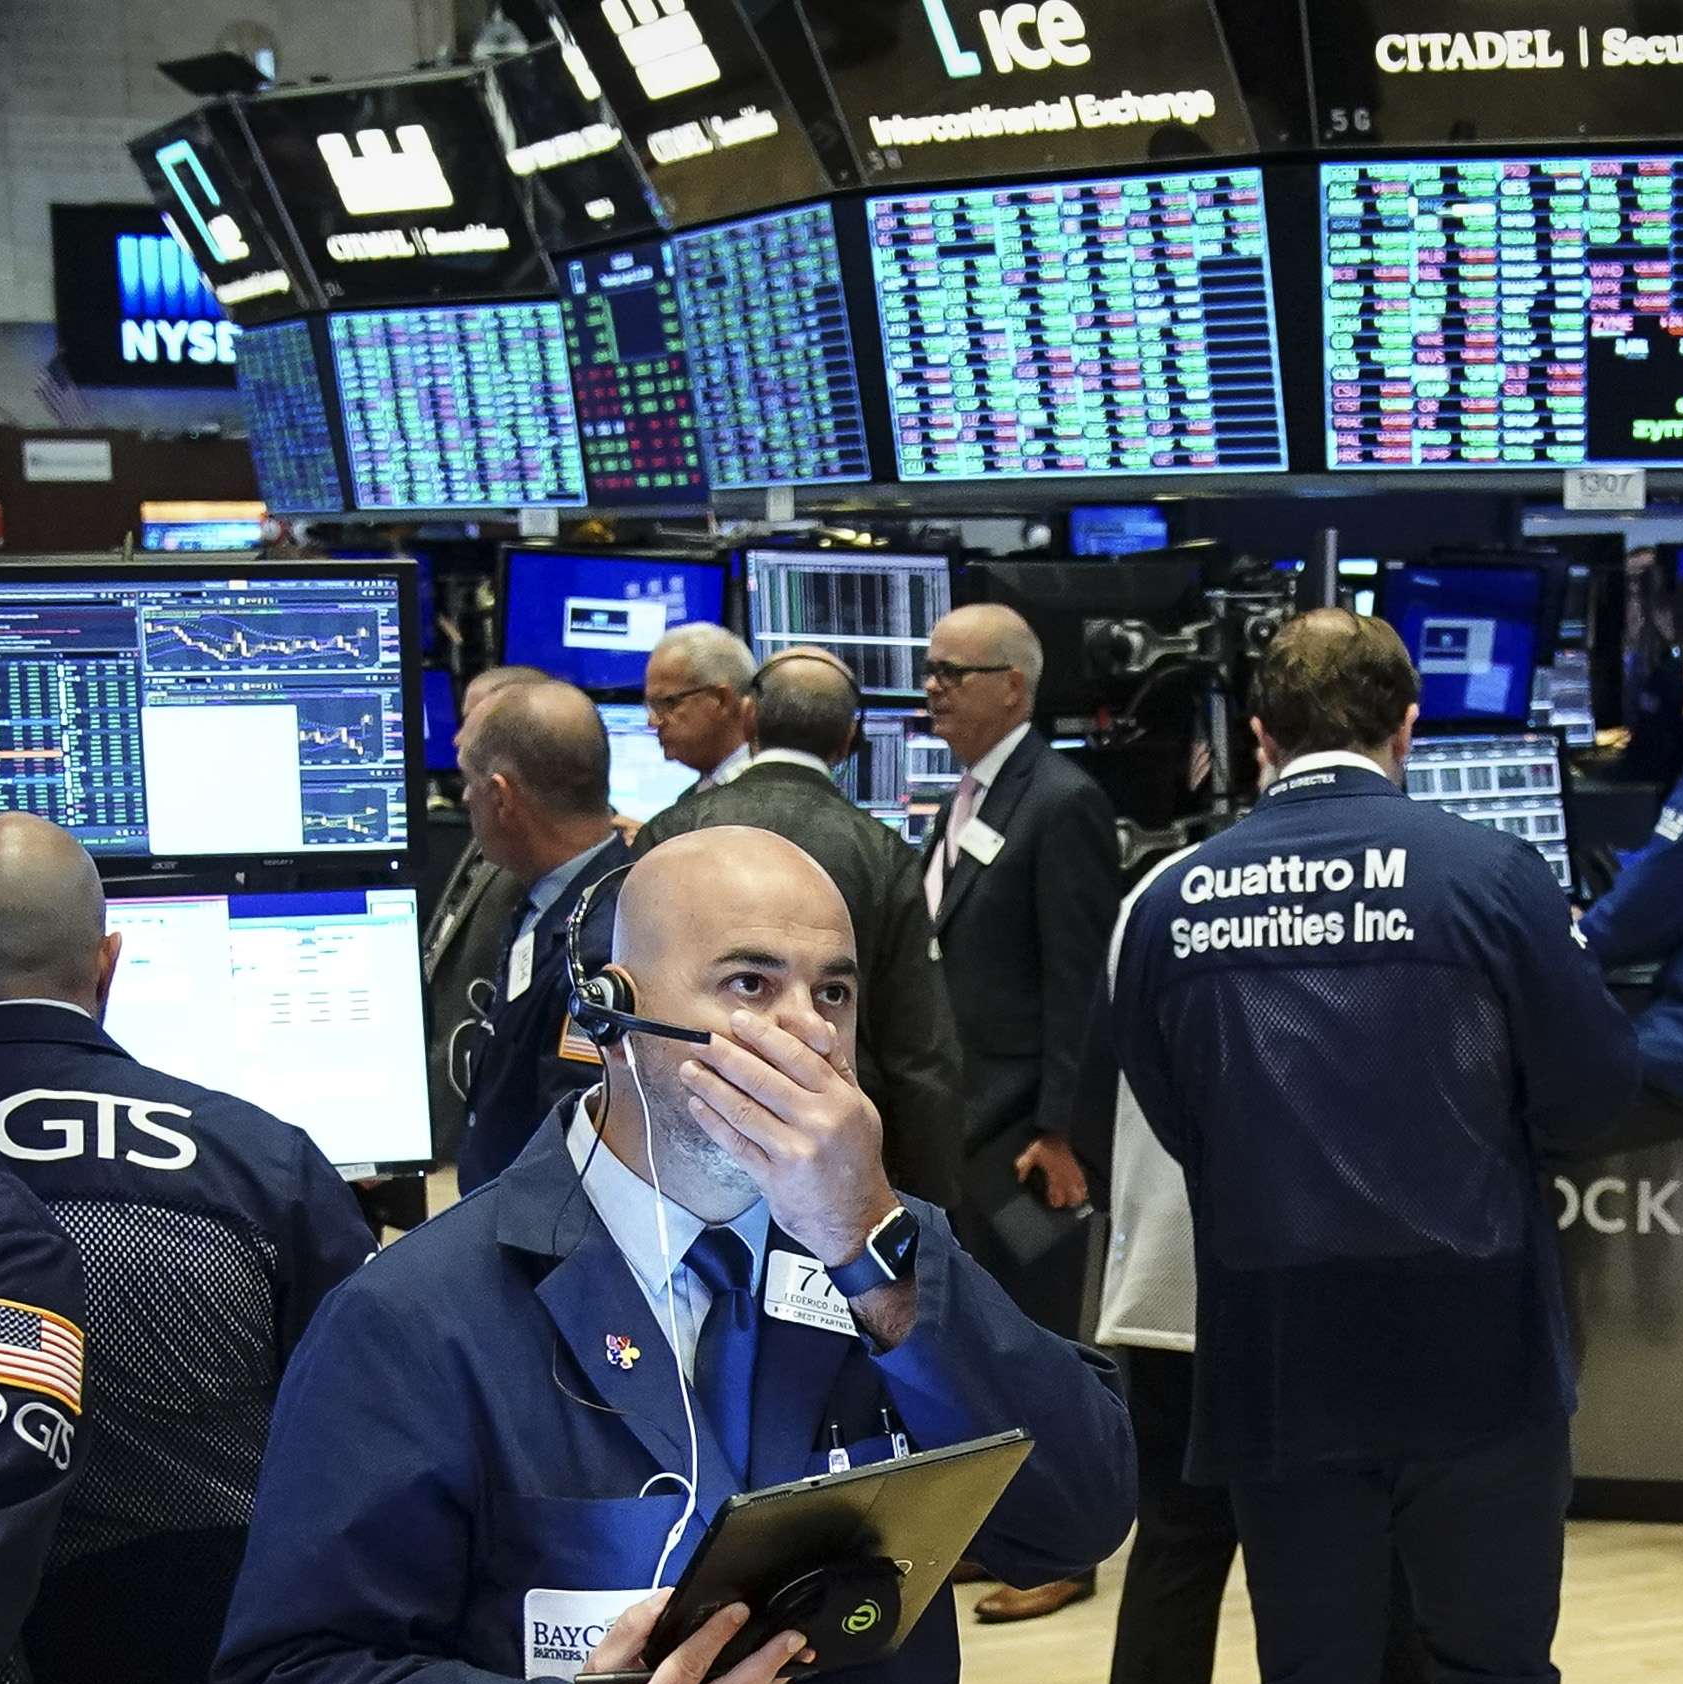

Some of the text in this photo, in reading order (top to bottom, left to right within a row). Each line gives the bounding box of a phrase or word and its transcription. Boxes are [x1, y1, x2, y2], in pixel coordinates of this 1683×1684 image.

[1376, 30, 1564, 72] CITADEL
[122, 319, 237, 363] NYSE
[1180, 848, 1407, 904] Quattro M
[1171, 902, 1415, 960] Securities Inc.
[13, 1402, 75, 1470] GTS
[533, 1621, 610, 1648] BAYC
[533, 1647, 585, 1664] PARTNERS,
